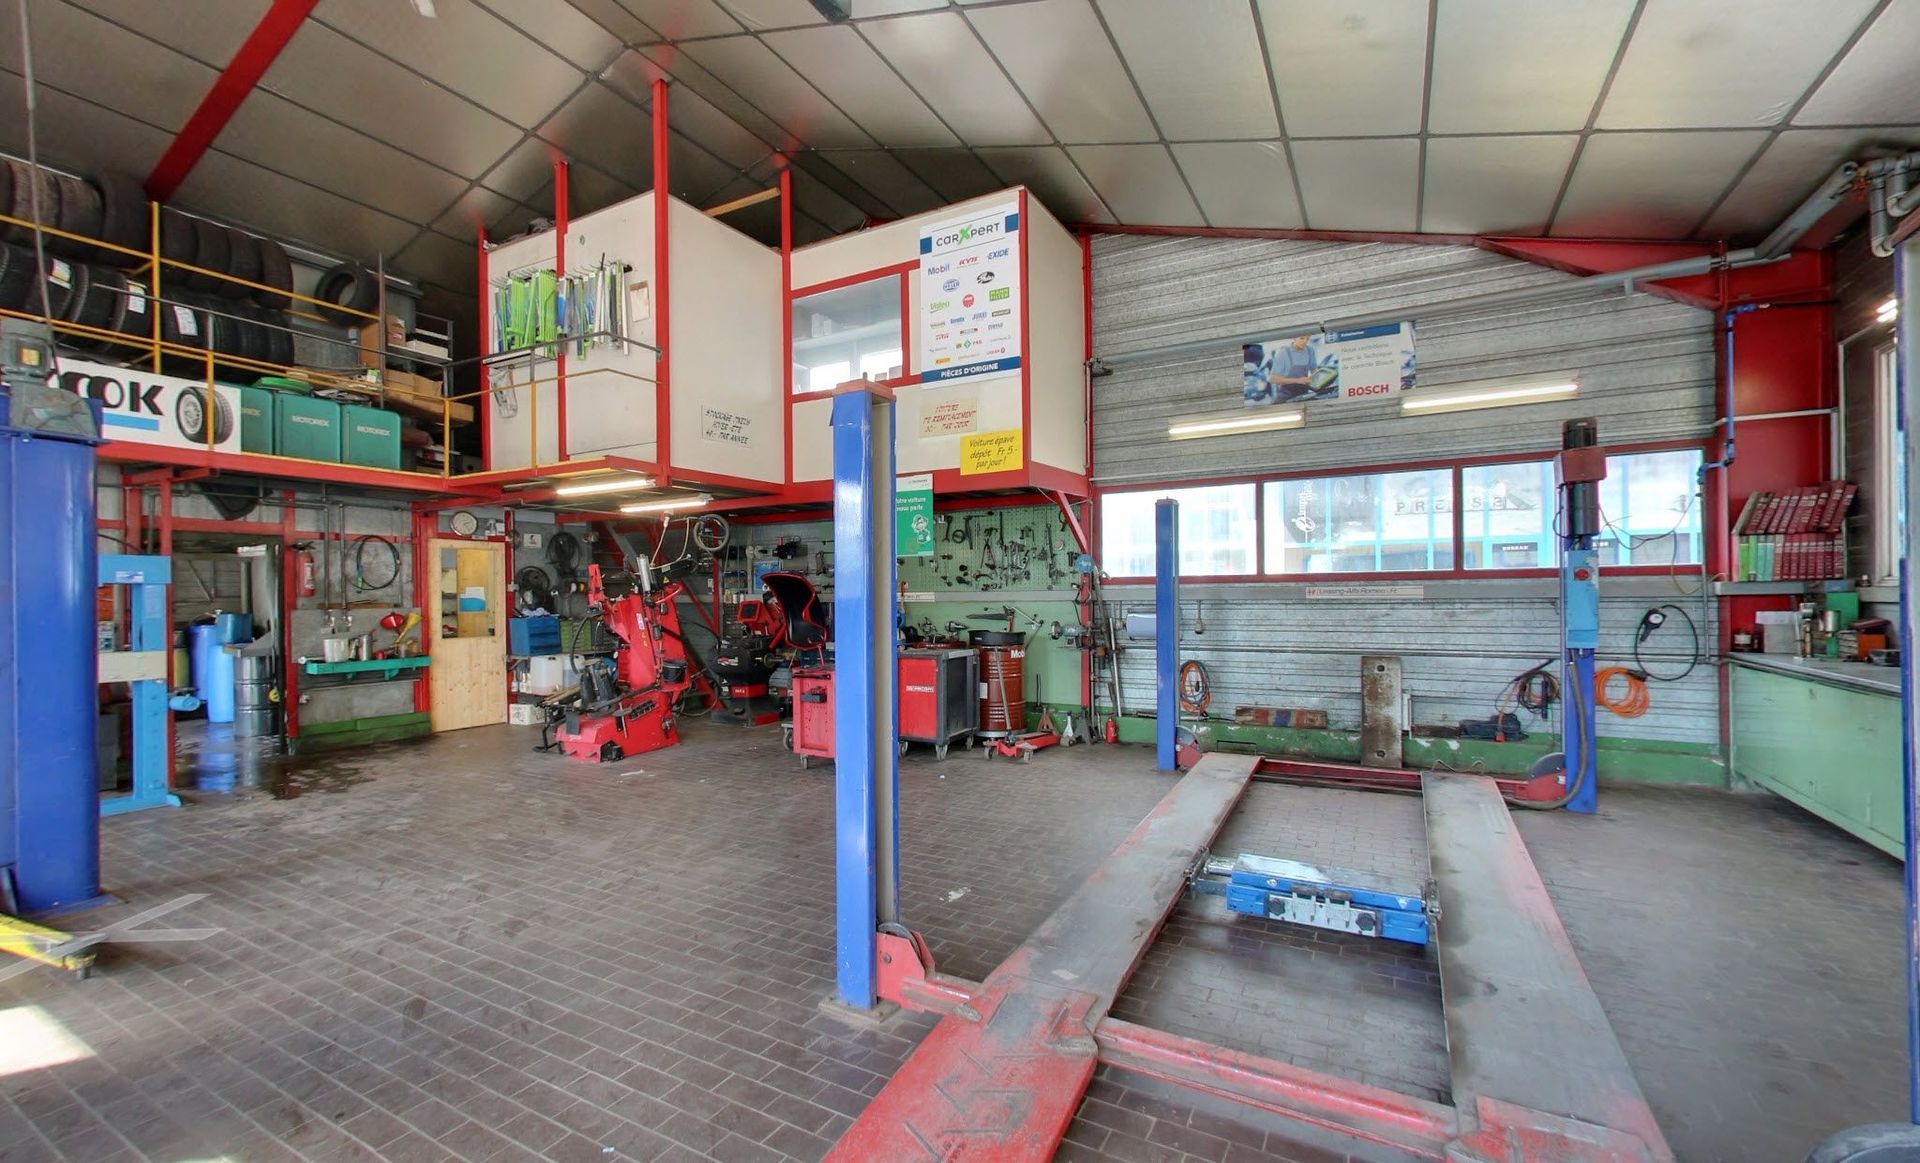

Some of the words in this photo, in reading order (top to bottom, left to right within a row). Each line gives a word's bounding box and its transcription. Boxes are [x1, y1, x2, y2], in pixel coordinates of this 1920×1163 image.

[987, 248, 1009, 260] EXIDE
[928, 264, 950, 276] Mobil
[941, 368, 963, 379] PIÈCES
[964, 363, 999, 374] D'ORIGINE
[46, 369, 165, 416] OOK
[1347, 384, 1389, 397] BOSCH
[291, 414, 329, 427] MOTOREX
[356, 424, 391, 436] MOTOREX
[969, 439, 993, 448] Voiture
[976, 460, 987, 470] par
